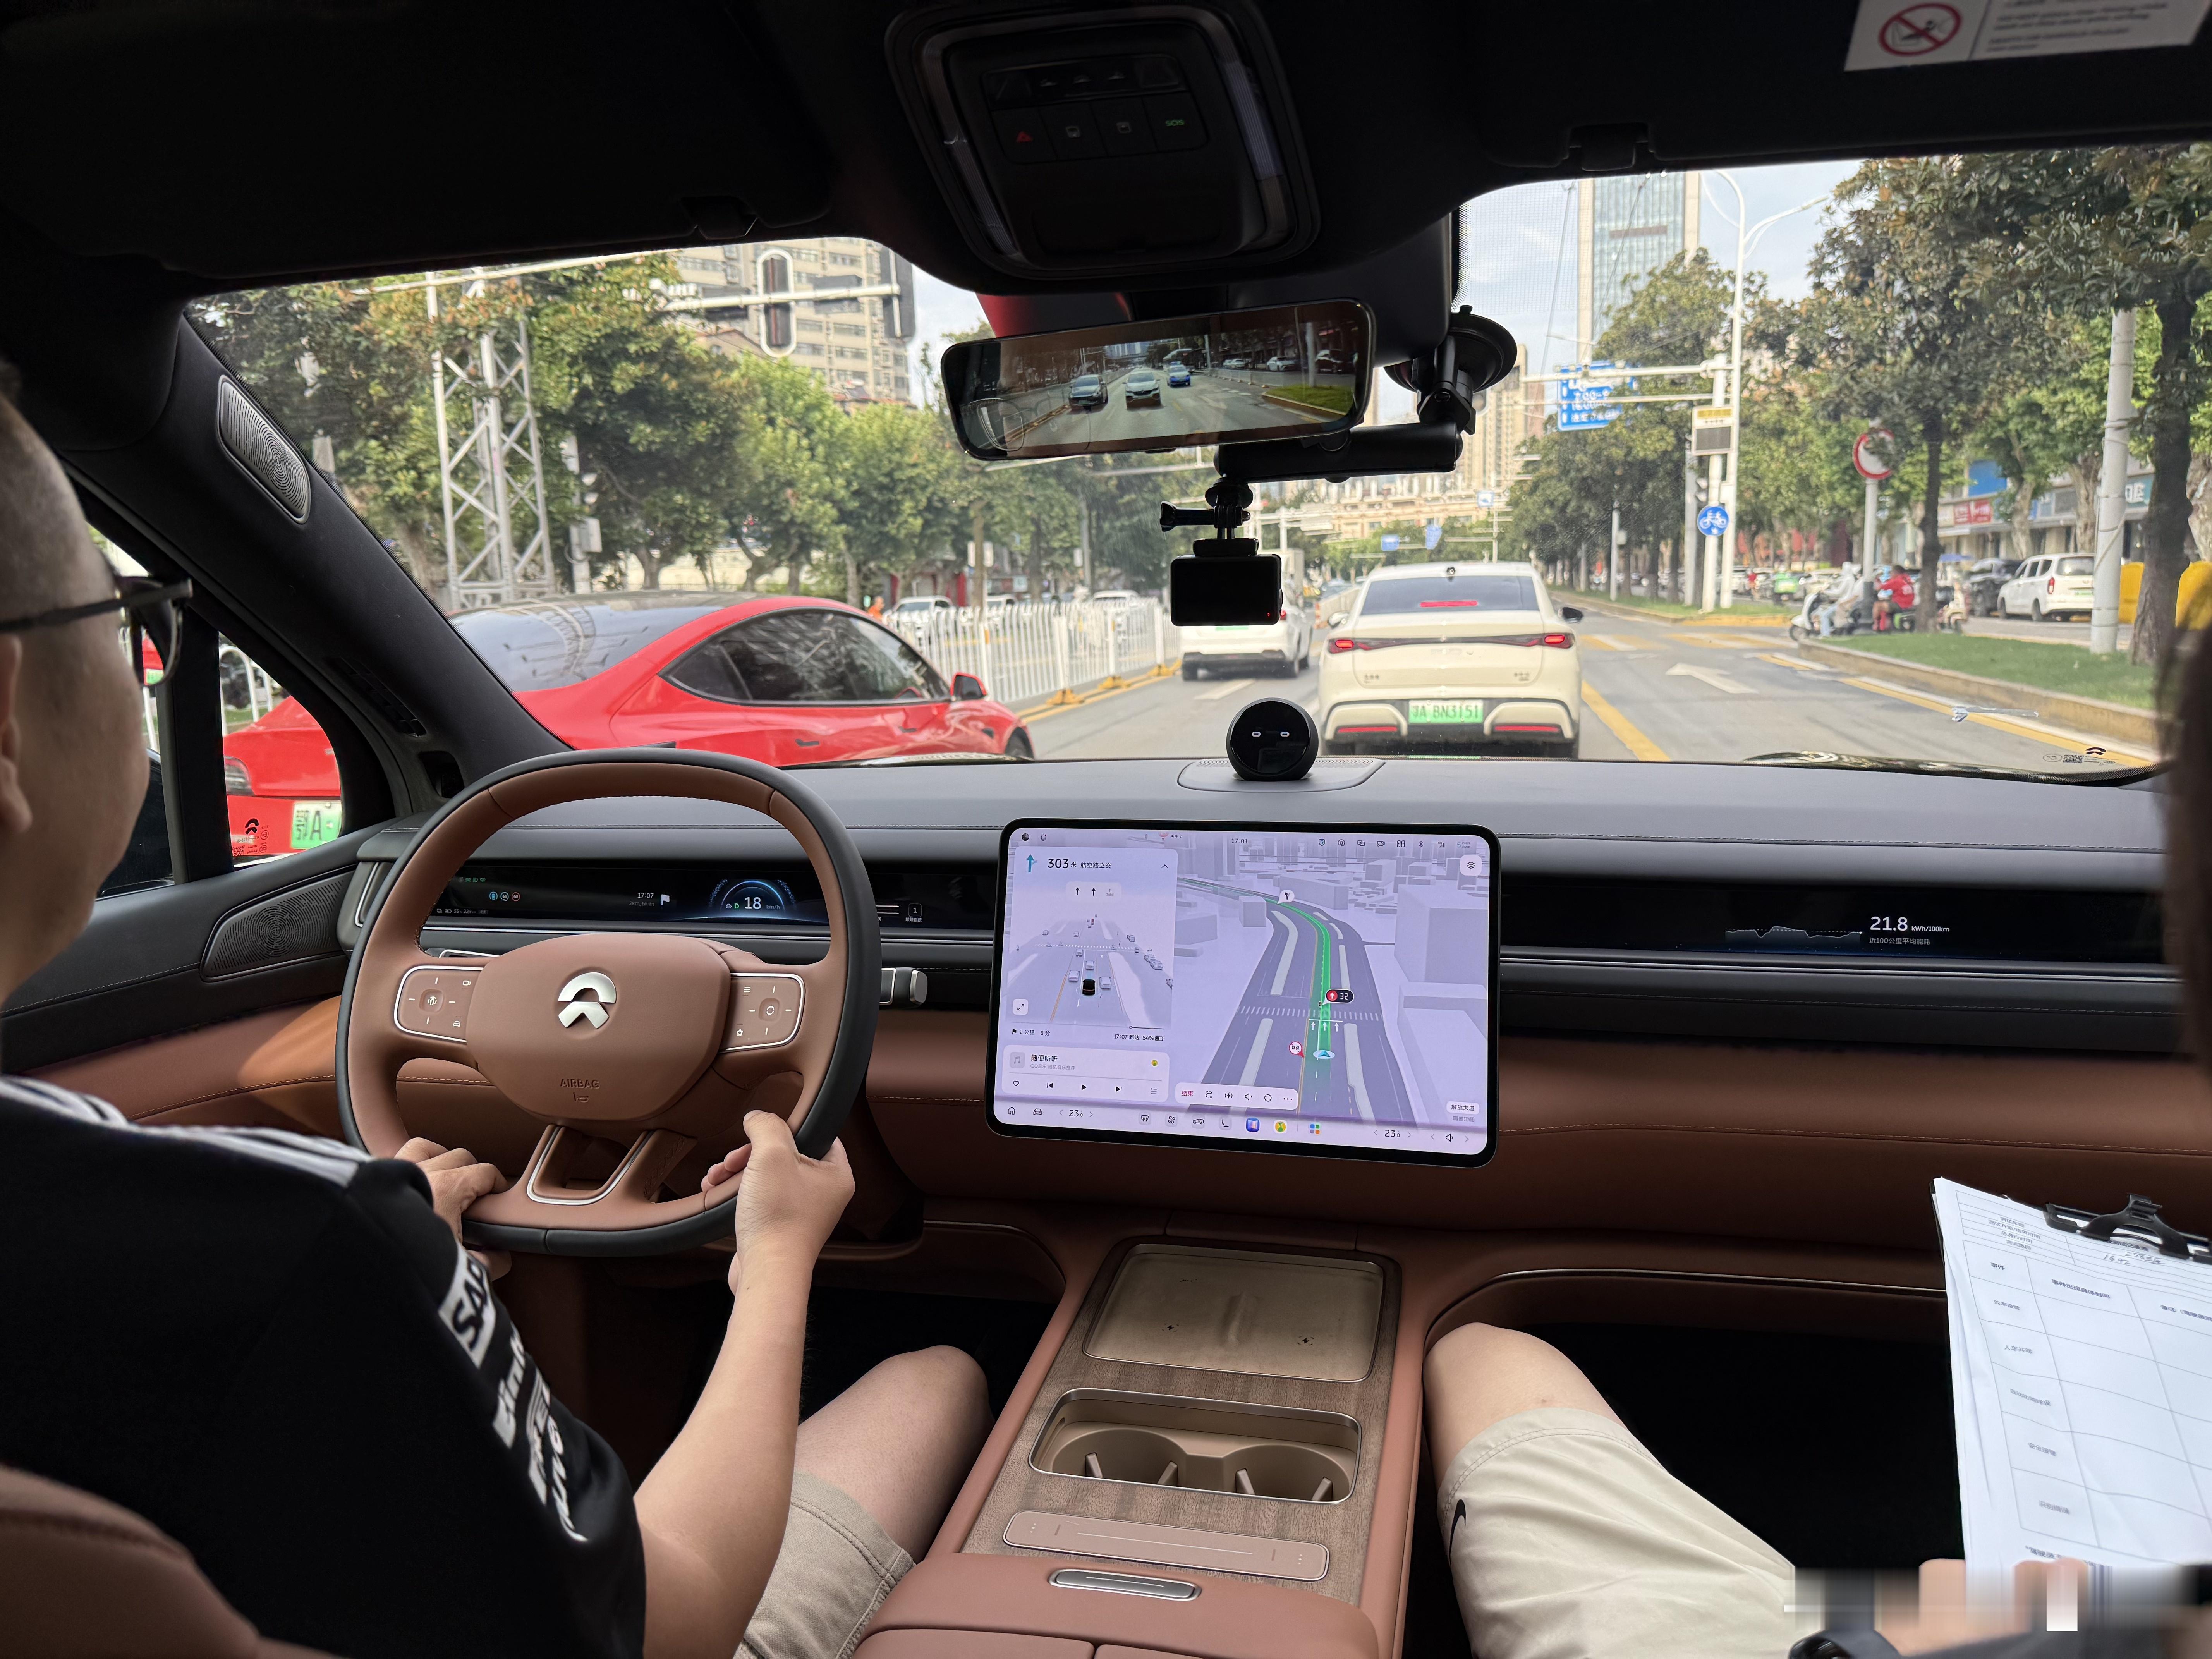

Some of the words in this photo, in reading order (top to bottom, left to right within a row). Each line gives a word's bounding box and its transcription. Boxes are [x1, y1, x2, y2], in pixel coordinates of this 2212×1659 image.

[1048, 858, 1069, 868] 303
[745, 896, 761, 910] 18
[1870, 916, 1908, 931] 21.8
[1869, 937, 1930, 945] 近100公里平均能耗
[560, 1078, 600, 1089] AIRBAG
[1990, 1262, 2005, 1271] 事件
[2051, 1279, 2111, 1299] 事件出现具体时间
